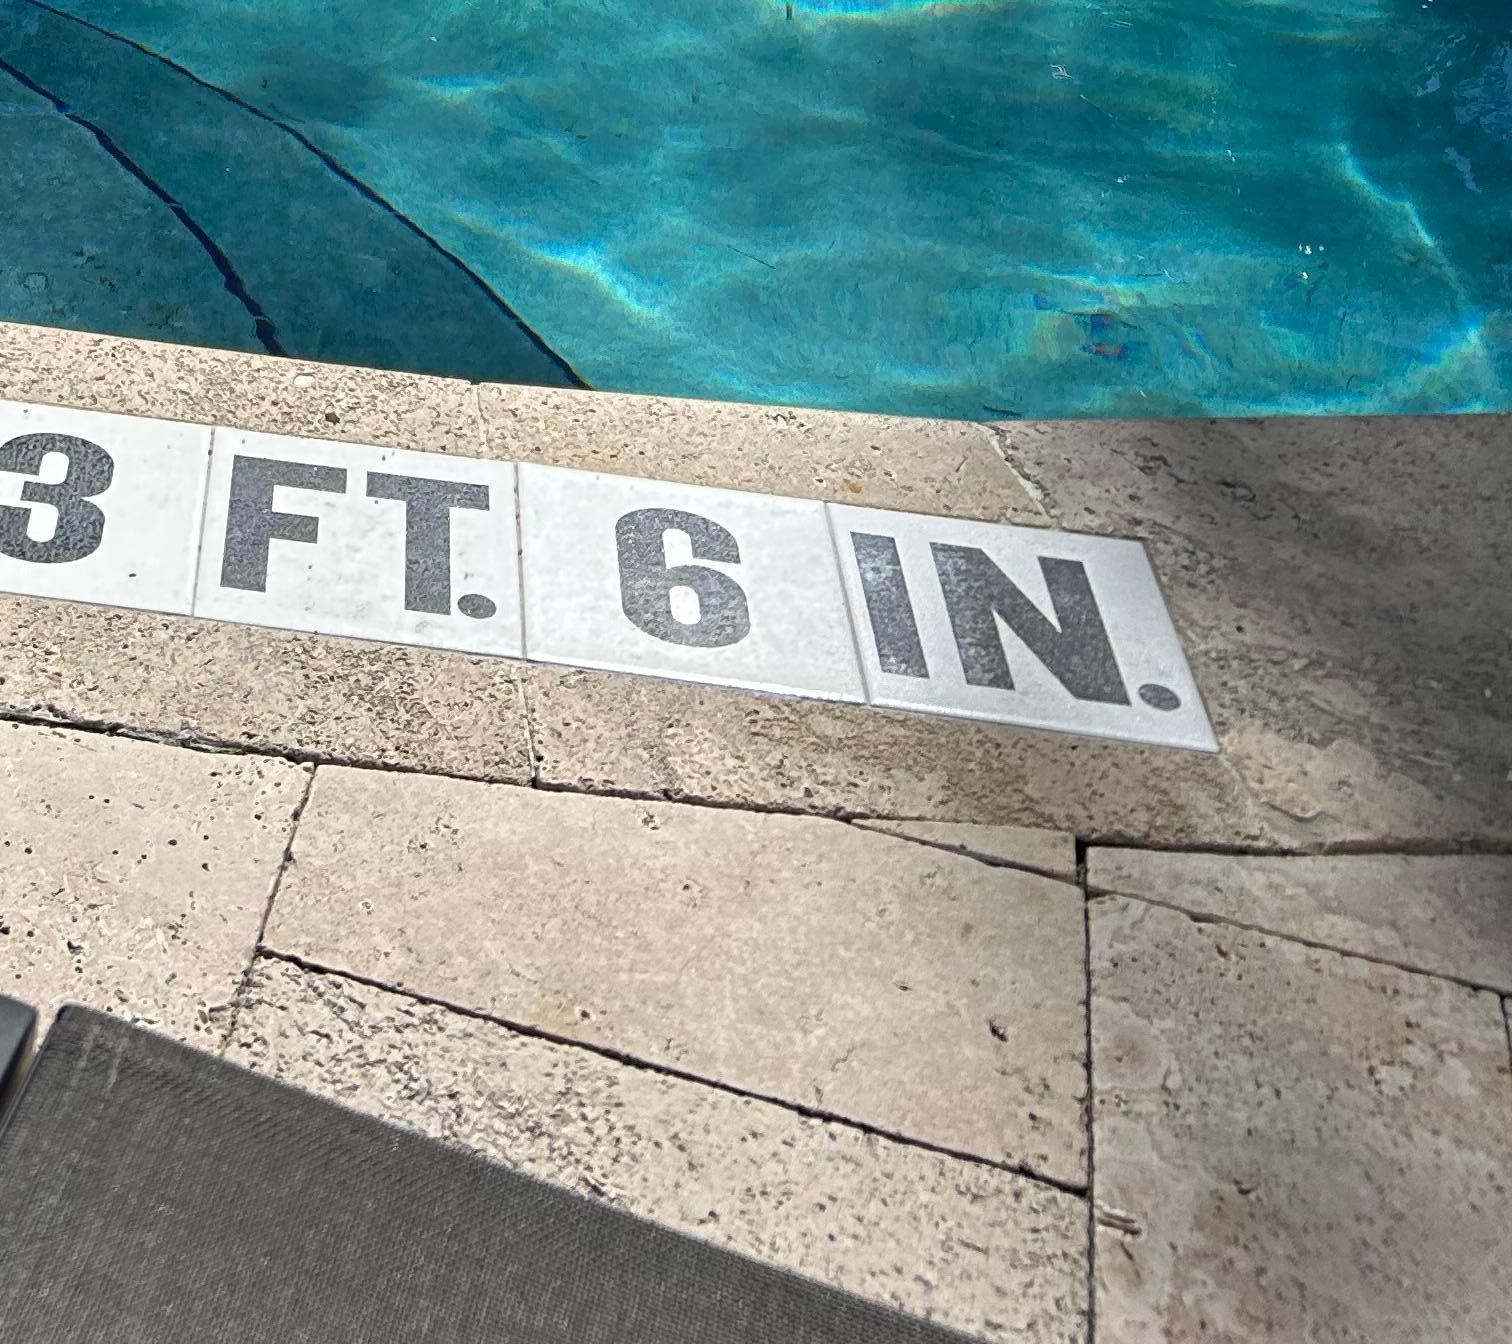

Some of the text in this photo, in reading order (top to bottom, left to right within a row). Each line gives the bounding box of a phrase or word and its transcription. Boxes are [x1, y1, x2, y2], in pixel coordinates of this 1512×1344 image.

[219, 454, 497, 620] FT.
[615, 507, 752, 649] 6
[849, 531, 1182, 712] IN.
